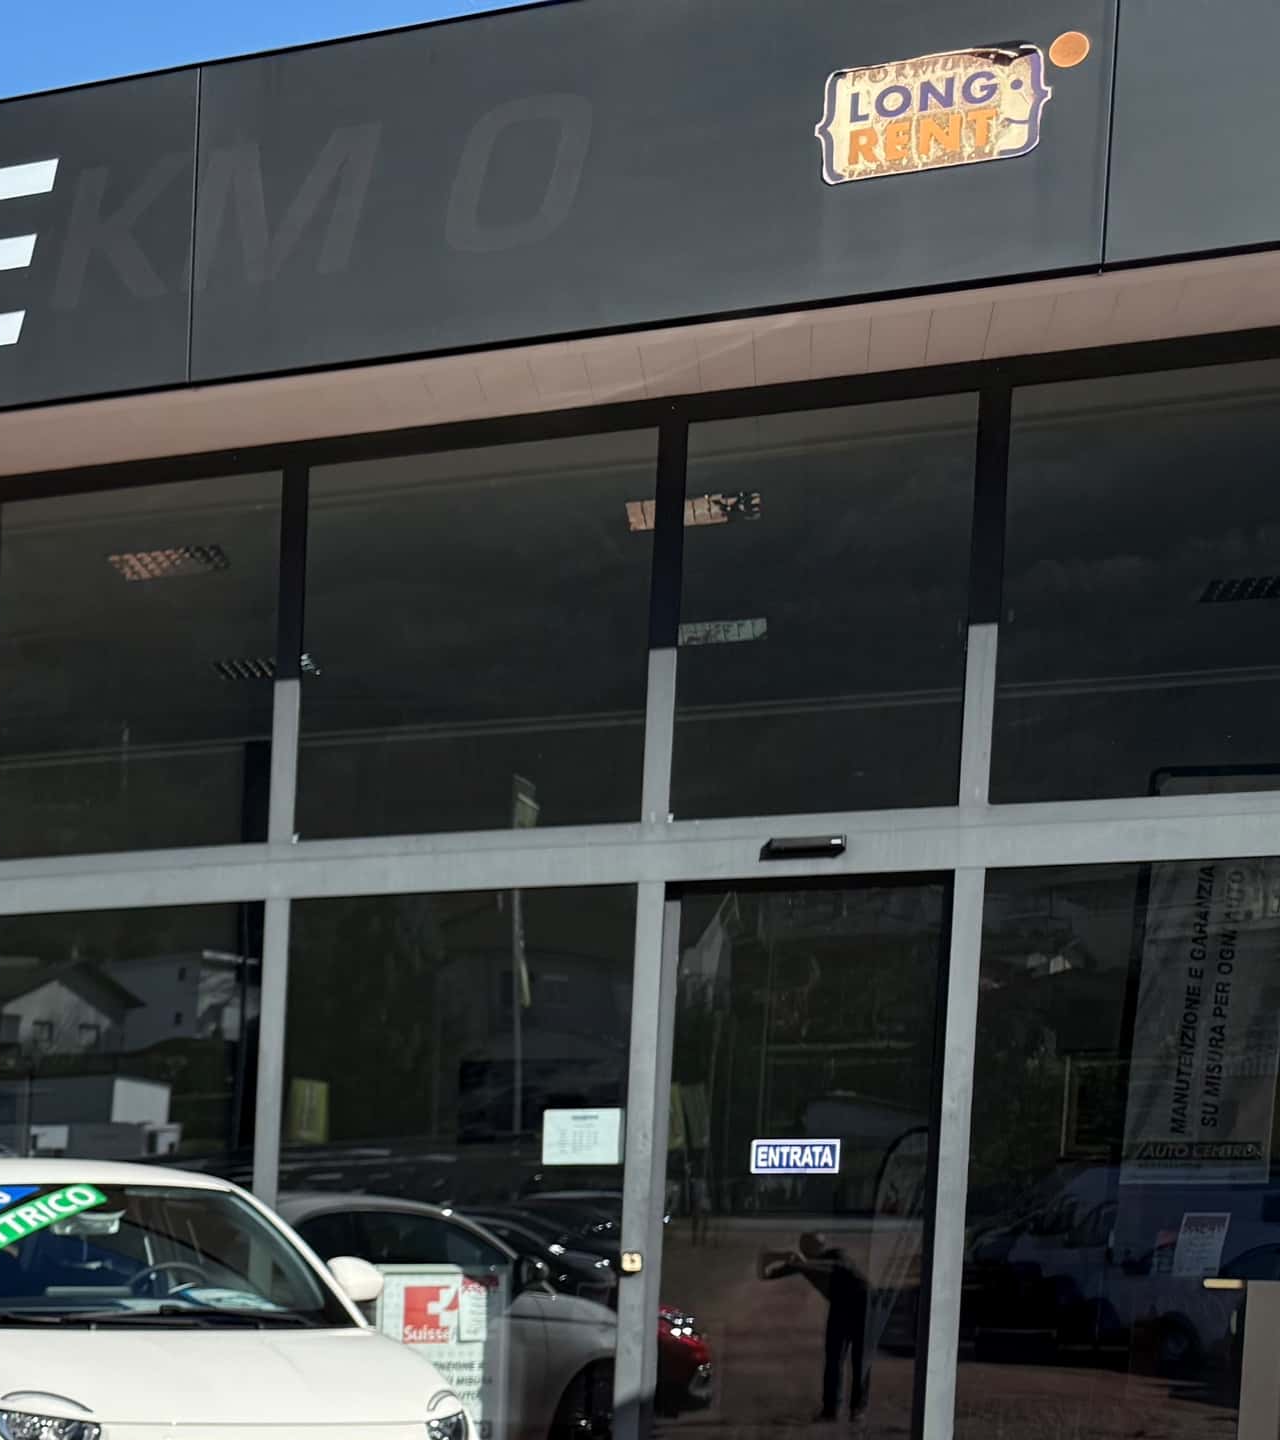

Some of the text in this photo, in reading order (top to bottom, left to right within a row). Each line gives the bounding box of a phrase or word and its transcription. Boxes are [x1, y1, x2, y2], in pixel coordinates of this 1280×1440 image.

[849, 70, 998, 124] LONG
[847, 107, 998, 166] RENT
[1214, 981, 1233, 1020] PER
[1170, 985, 1203, 1135] MANUTENZIONE
[1202, 1023, 1225, 1098] MISURA
[1204, 1101, 1219, 1128] SU
[757, 1145, 835, 1168] ENTRATA
